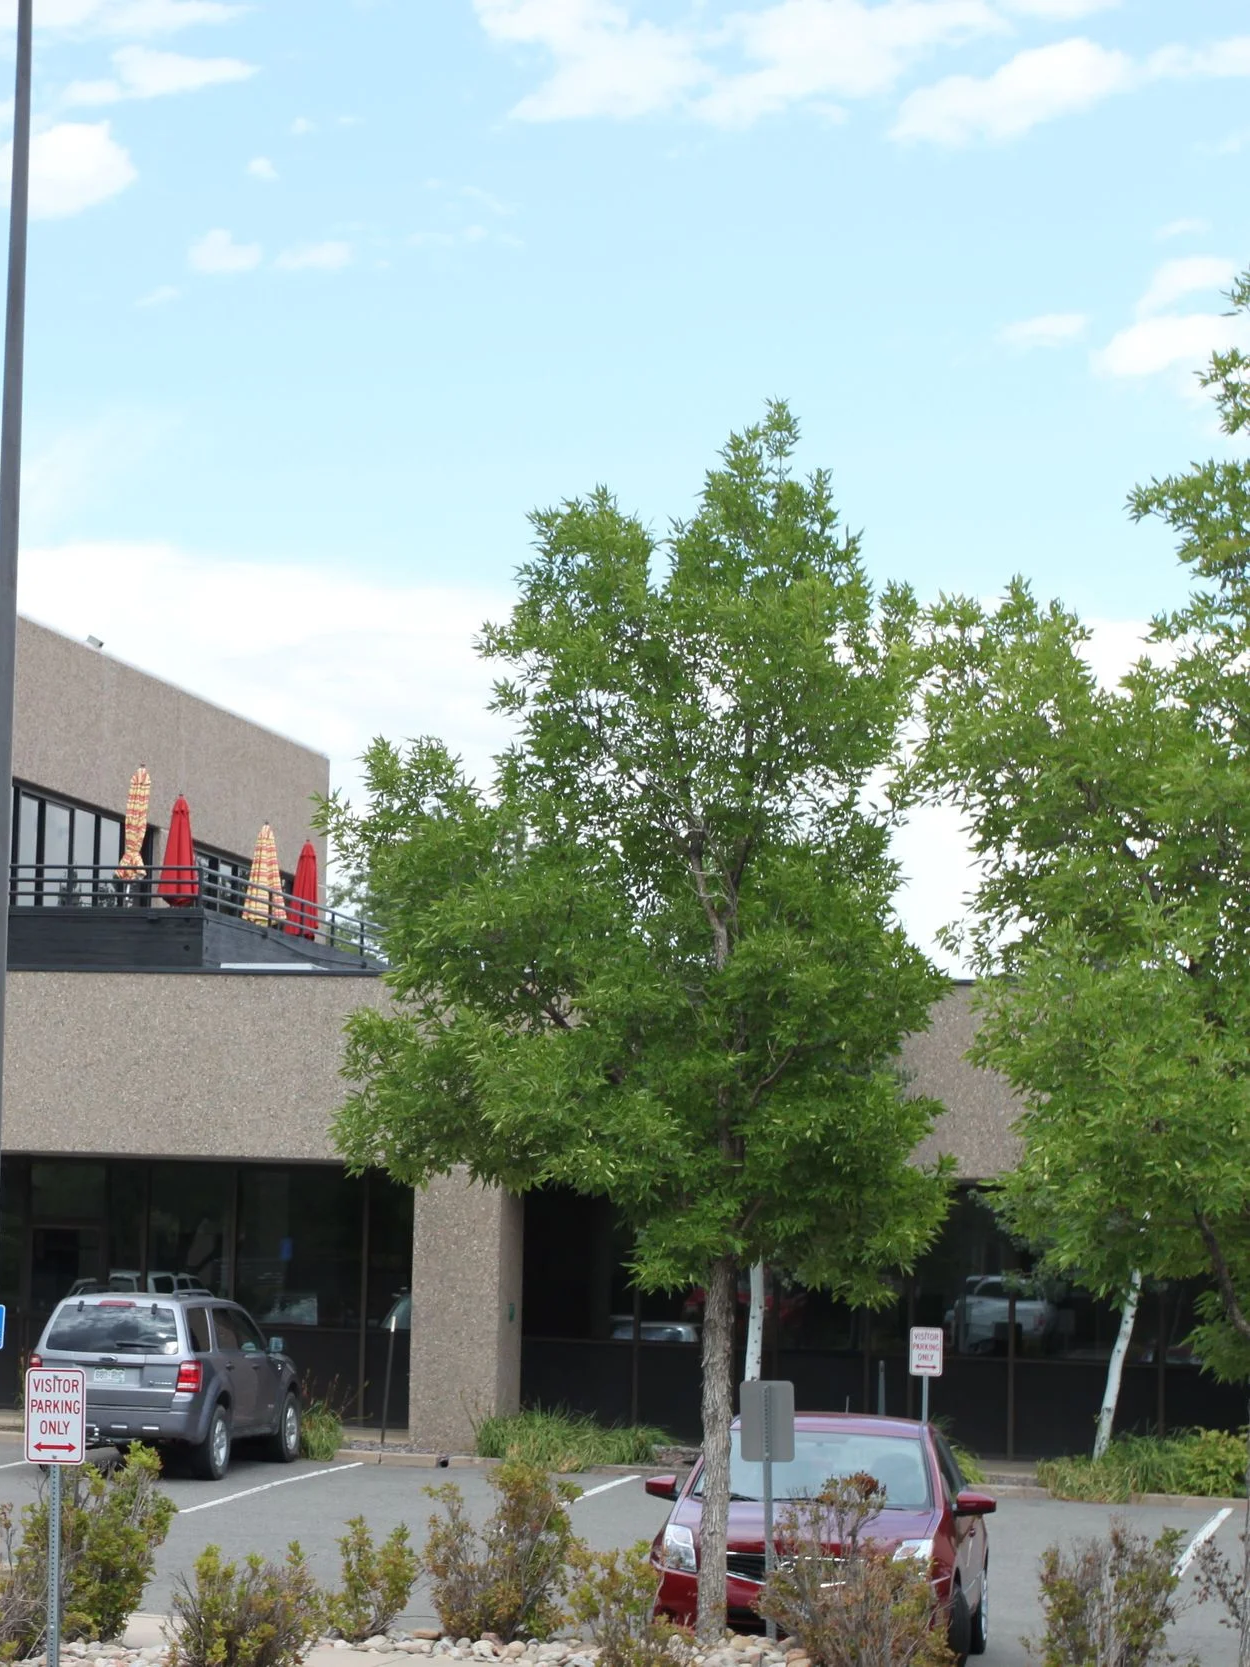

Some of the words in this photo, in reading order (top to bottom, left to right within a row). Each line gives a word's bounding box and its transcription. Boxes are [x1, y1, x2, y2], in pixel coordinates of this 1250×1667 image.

[914, 1332, 939, 1340] VISITOR
[913, 1342, 940, 1351] PARKING
[917, 1353, 934, 1361] ONLY
[33, 1378, 80, 1393] VISITOR
[30, 1399, 80, 1415] PARKING
[39, 1420, 70, 1435] ONLY
